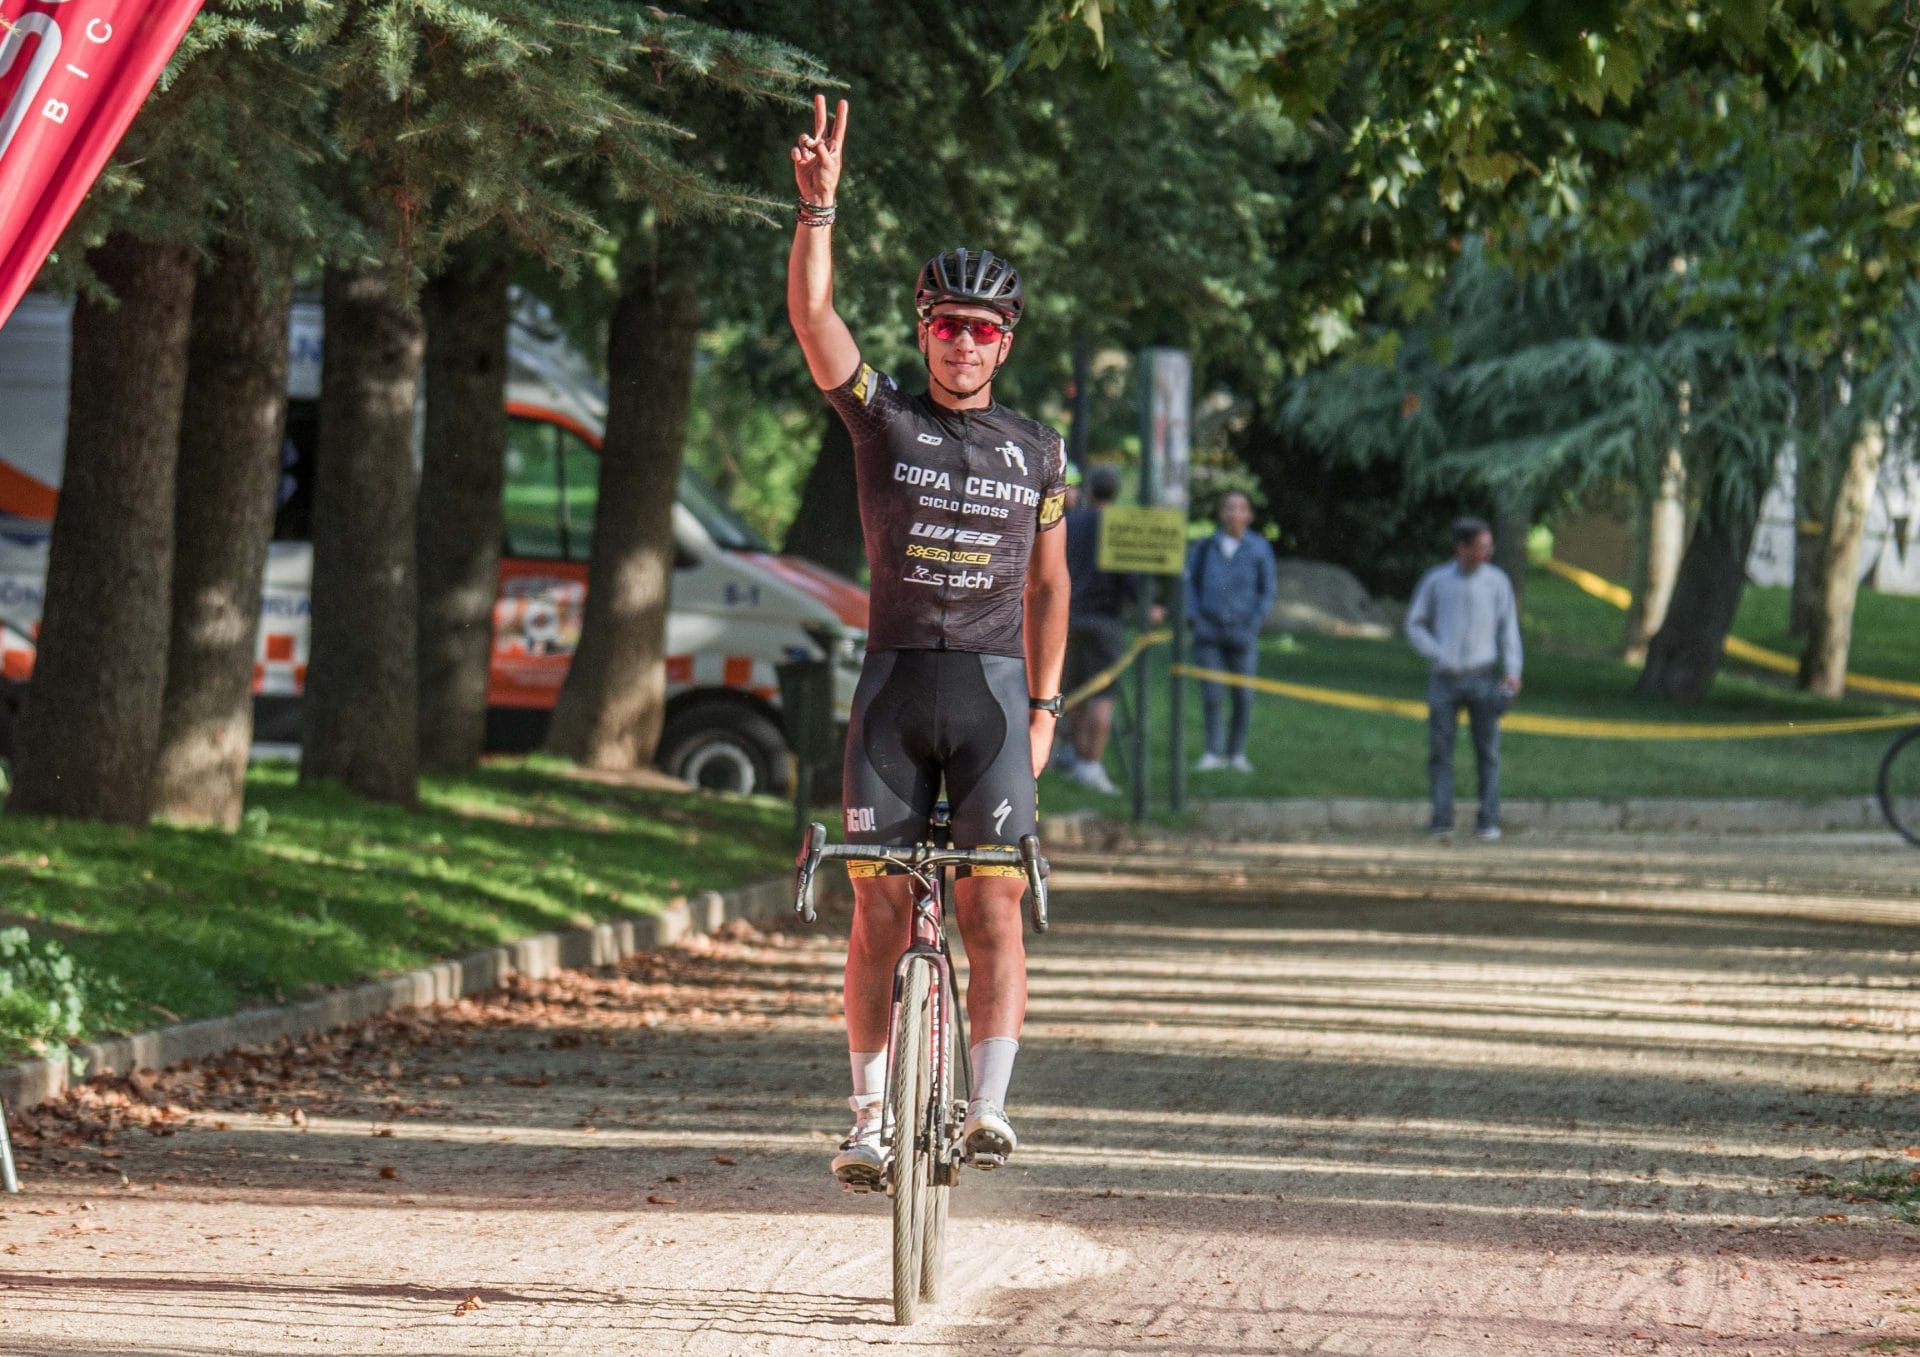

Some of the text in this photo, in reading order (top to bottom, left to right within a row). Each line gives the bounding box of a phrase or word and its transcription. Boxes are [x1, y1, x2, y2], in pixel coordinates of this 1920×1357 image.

[894, 462, 951, 491] COPA
[919, 495, 1010, 519] CICLO CROSS
[906, 544, 992, 565] X-SAUCE
